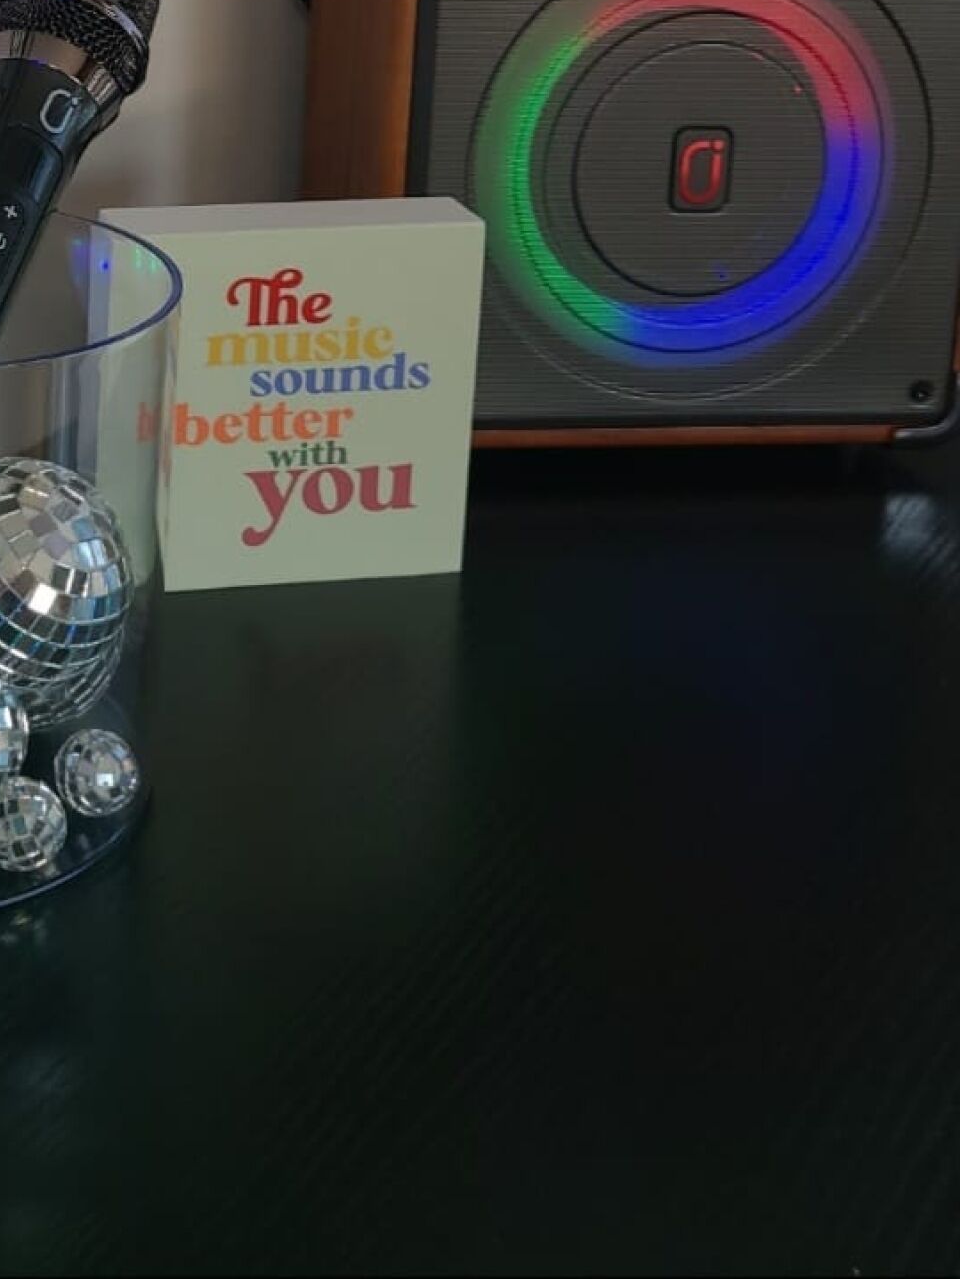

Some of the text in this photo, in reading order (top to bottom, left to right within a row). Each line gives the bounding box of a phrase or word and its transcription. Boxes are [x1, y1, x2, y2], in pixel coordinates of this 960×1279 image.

[226, 267, 333, 327] The
[205, 316, 394, 367] music
[249, 352, 431, 397] sounds
[172, 401, 354, 446] better
[268, 441, 348, 468] with
[241, 463, 417, 547] you
